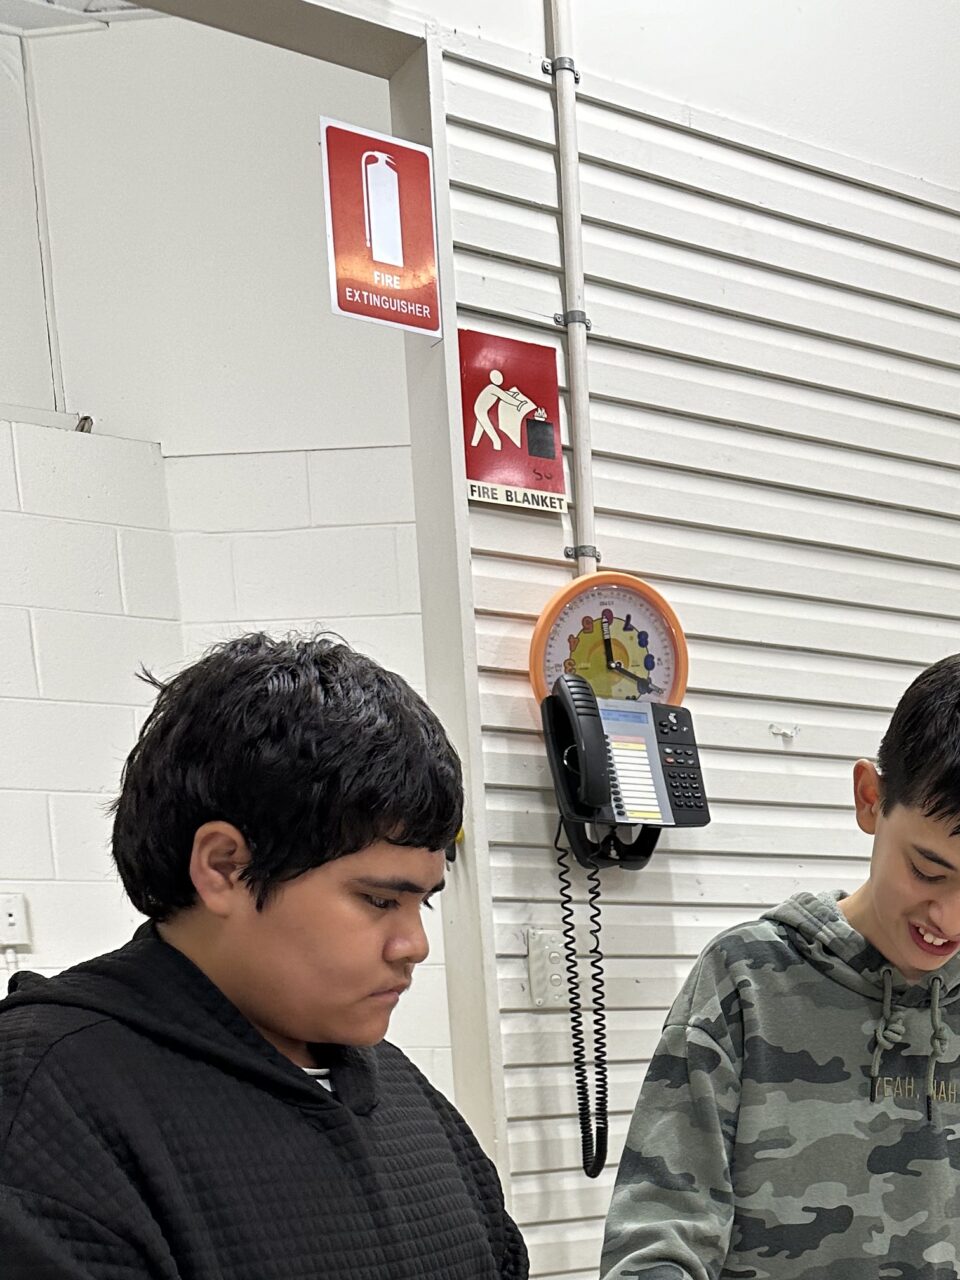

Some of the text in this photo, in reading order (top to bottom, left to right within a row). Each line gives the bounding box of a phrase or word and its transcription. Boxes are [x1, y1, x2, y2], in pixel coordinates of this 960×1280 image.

[373, 271, 401, 290] FIRE
[345, 287, 431, 319] EXTINGUISHER
[470, 484, 564, 510] FIRE BLANKET
